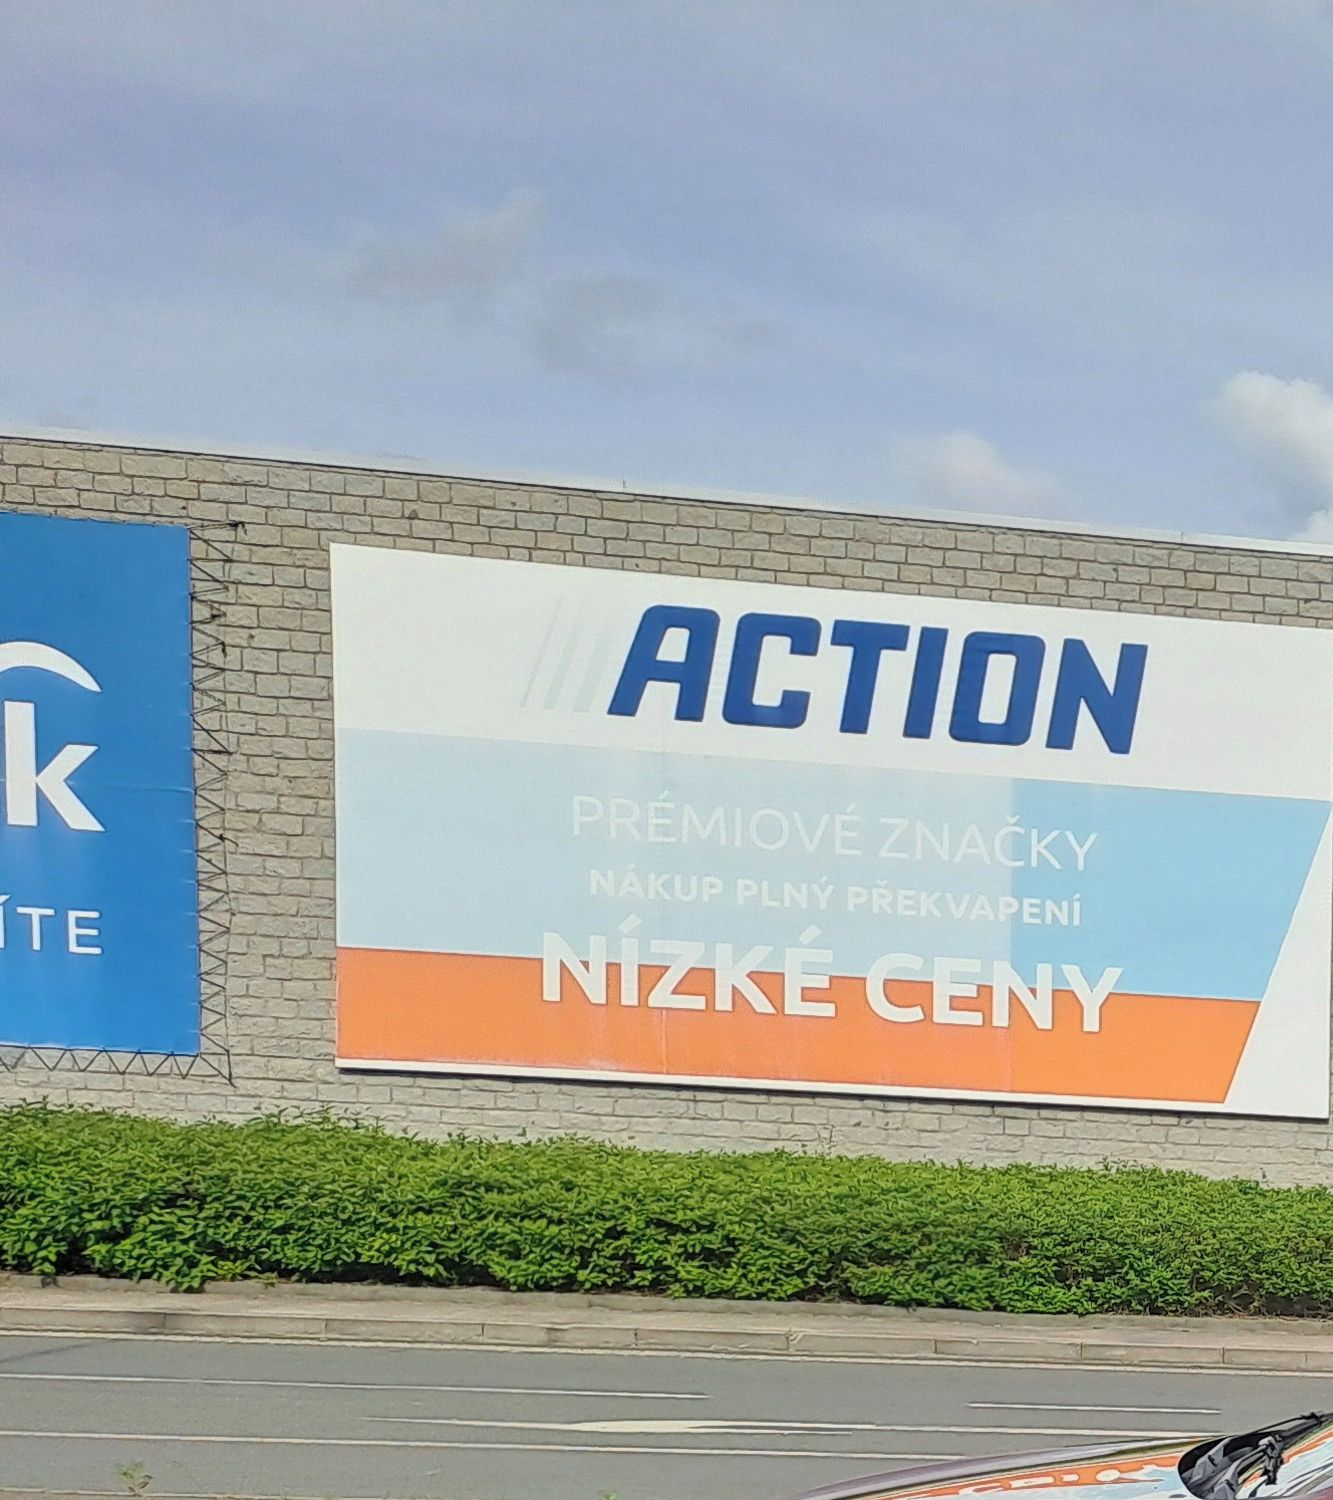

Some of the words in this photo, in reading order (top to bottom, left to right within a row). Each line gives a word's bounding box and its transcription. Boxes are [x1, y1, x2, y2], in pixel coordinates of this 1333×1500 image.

[607, 604, 1148, 756] ACTION
[572, 791, 861, 857] PRÉMIOVÉ
[880, 815, 1099, 872] ZNAČKY
[588, 866, 725, 905] NÁKUP
[736, 873, 834, 914] PLNÝ
[847, 881, 1083, 928] PŘEKVAPENÍ
[541, 913, 836, 1018] NÍZKÉ
[866, 952, 1125, 1033] CENY
